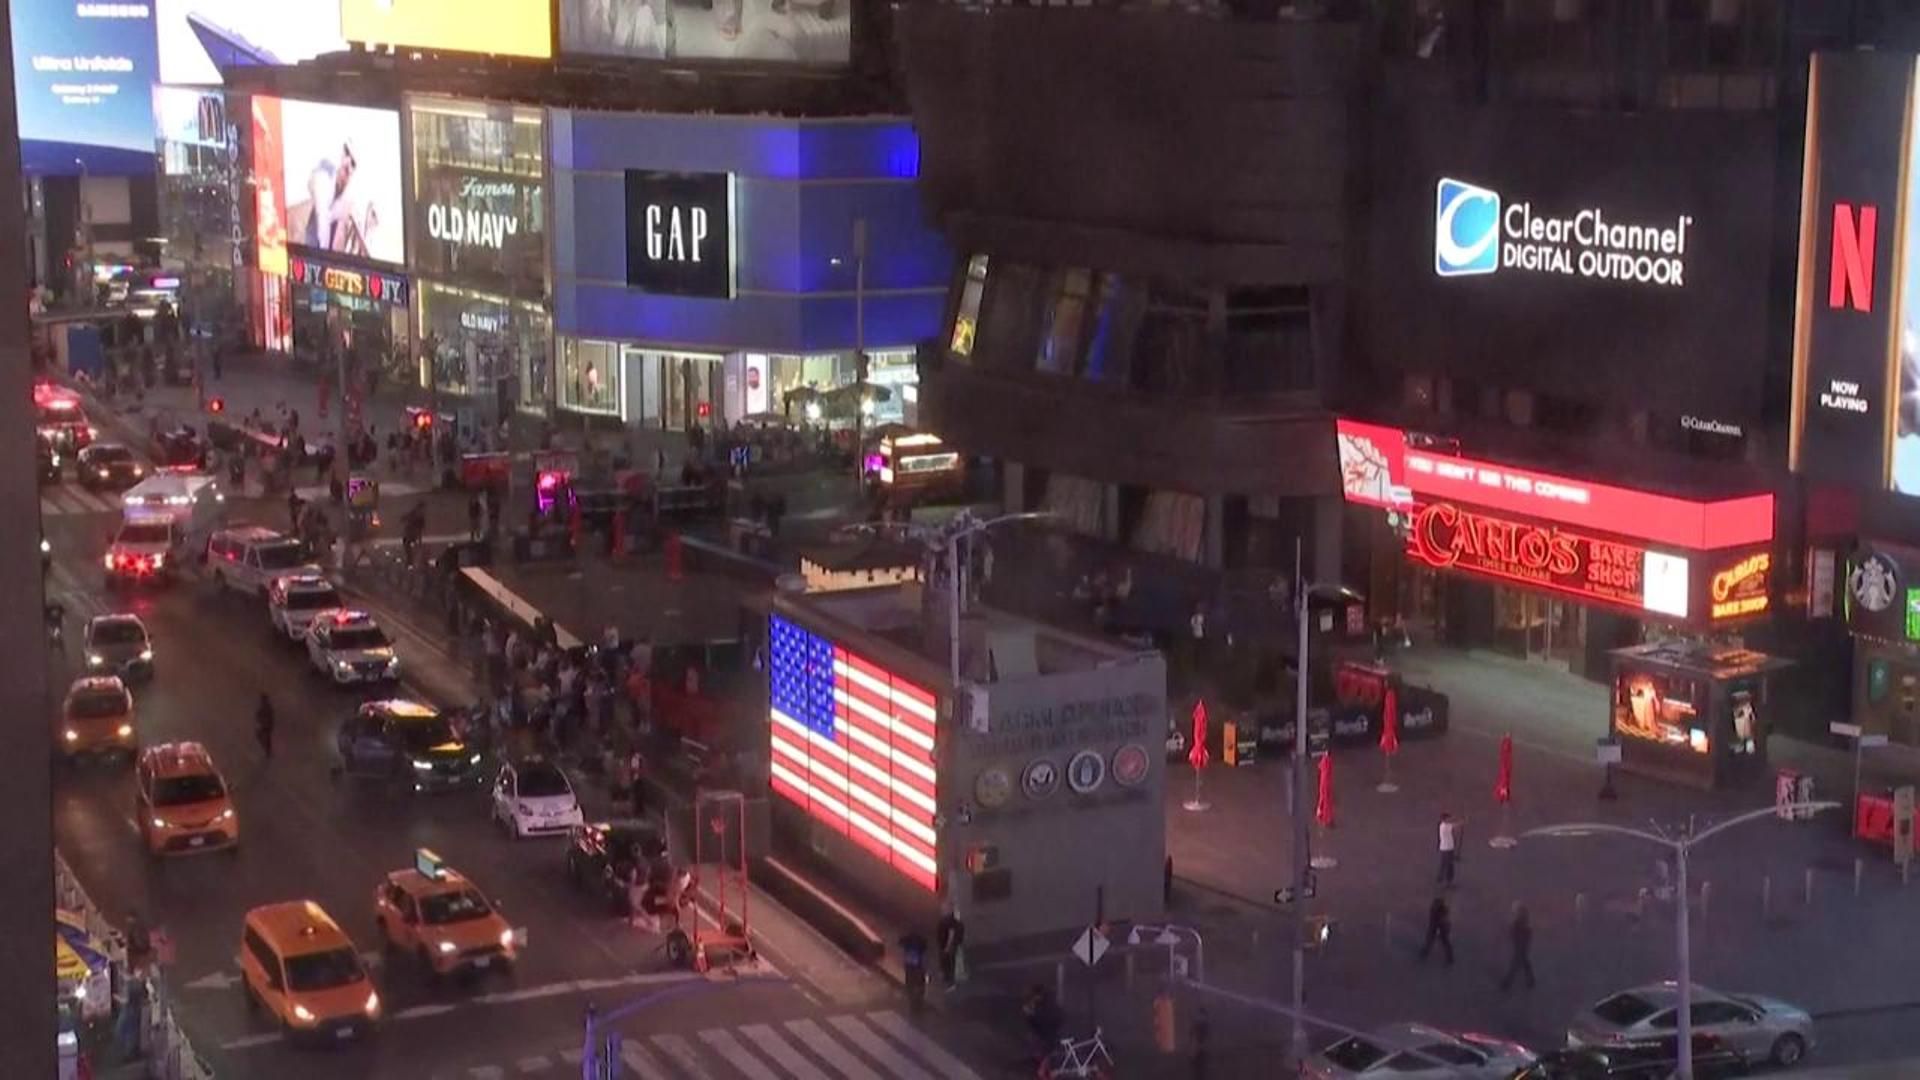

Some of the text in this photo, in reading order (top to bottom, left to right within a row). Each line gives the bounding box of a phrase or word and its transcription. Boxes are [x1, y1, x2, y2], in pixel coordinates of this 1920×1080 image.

[428, 203, 464, 242] OLD
[646, 204, 707, 262] GAP
[1505, 202, 1686, 254] ClearChannel
[1503, 244, 1683, 286] DIGITAL OUTDOOR
[1829, 203, 1877, 313] N
[325, 266, 363, 295] GIFTS
[1821, 393, 1868, 414] PLAYING
[1831, 379, 1860, 396] NOW
